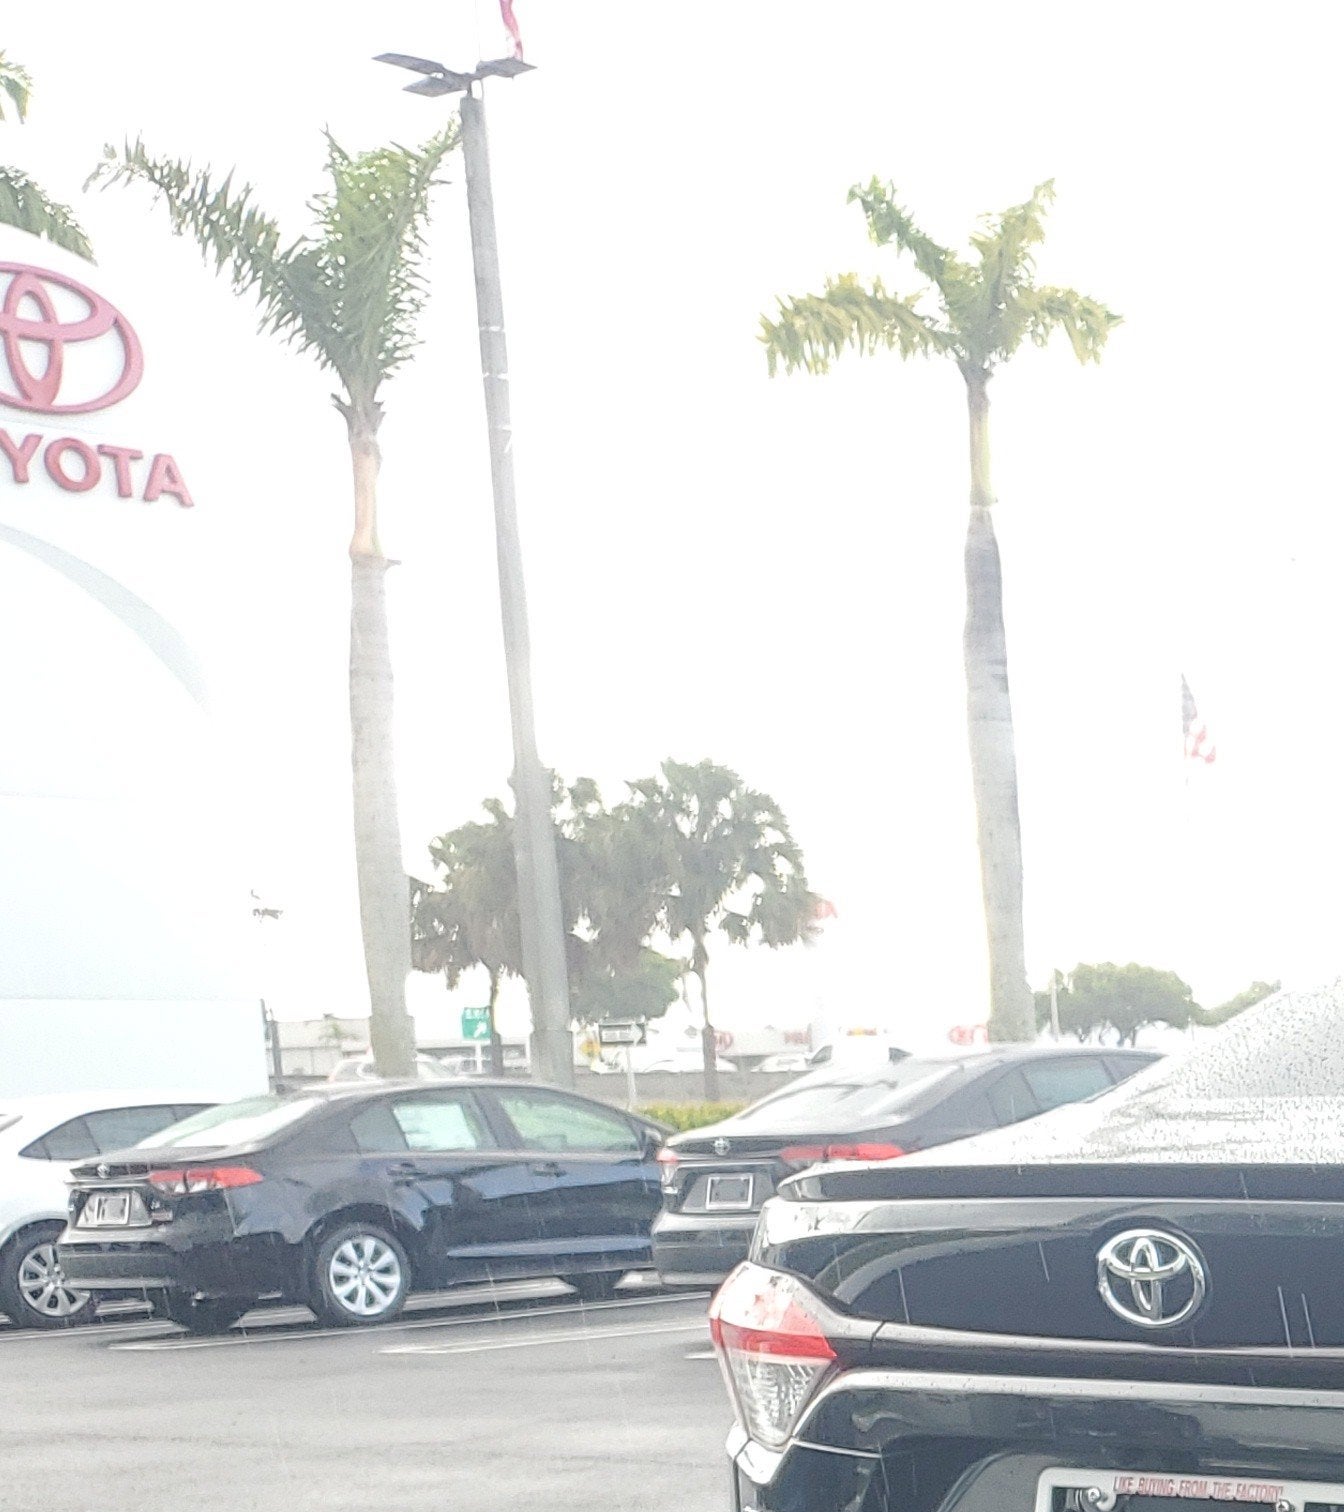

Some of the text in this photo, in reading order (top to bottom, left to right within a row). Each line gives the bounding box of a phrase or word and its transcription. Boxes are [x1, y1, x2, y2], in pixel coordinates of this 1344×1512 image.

[0, 427, 195, 508] YOTA
[1113, 1476, 1135, 1495] LIKE
[1138, 1477, 1175, 1496] BUYING
[1178, 1479, 1208, 1499] FROM
[1212, 1481, 1233, 1499] THE
